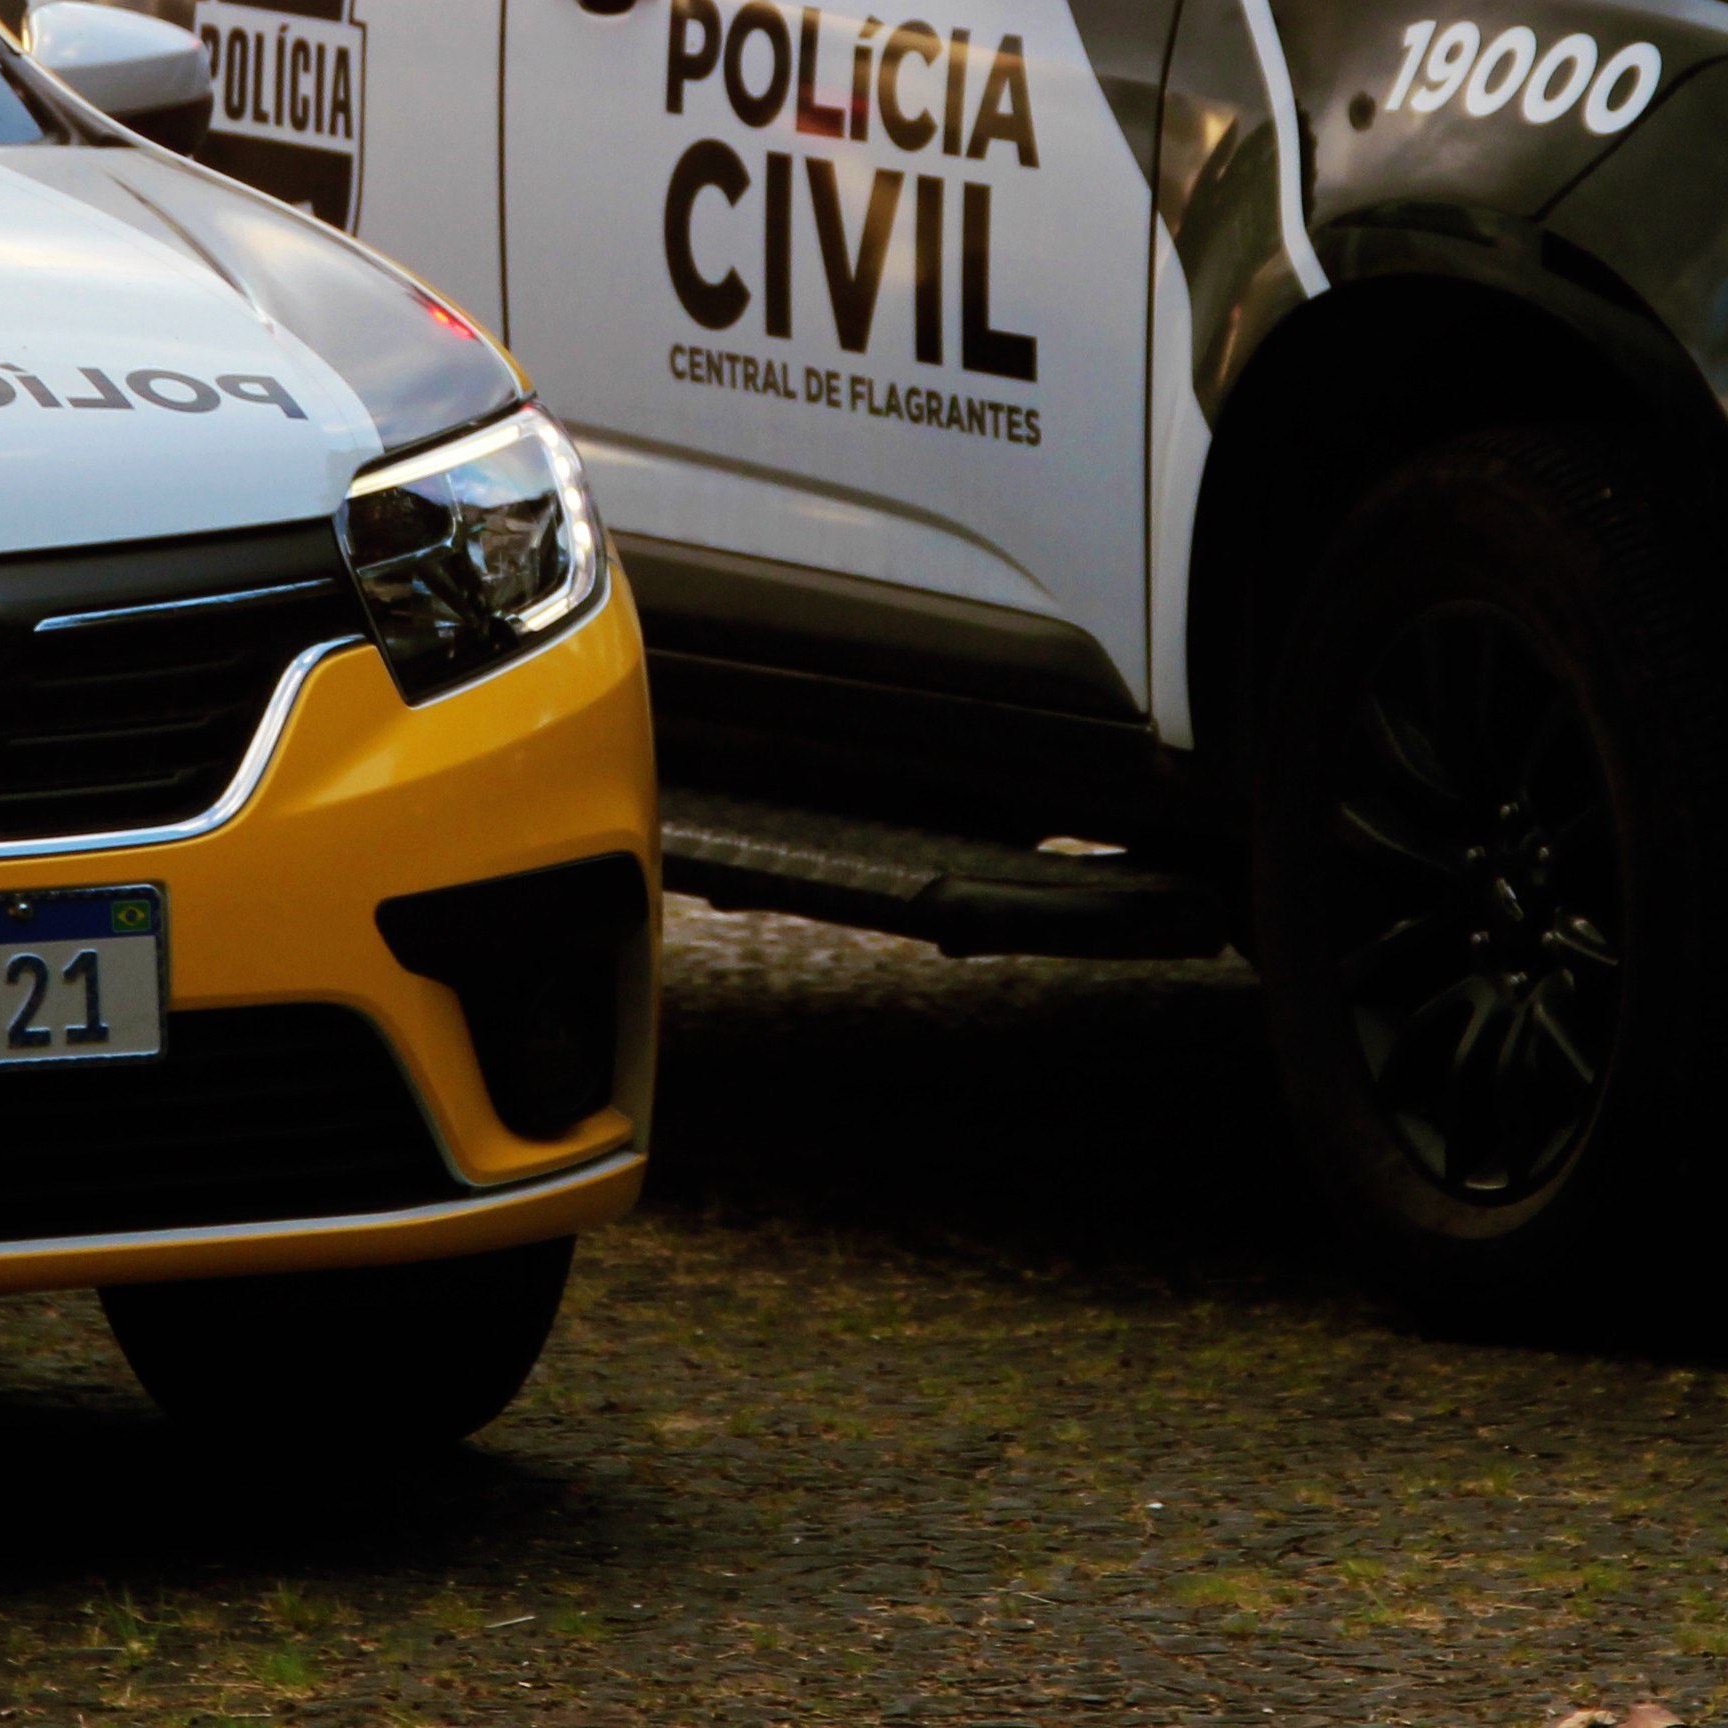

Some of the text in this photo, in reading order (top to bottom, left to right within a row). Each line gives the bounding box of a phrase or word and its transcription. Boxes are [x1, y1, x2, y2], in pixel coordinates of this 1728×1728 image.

[200, 22, 354, 140] POLÍCIA
[1385, 19, 1663, 135] 19000
[664, 138, 1038, 383] CIVIL
[669, 343, 1042, 448] CENTRAL DE FLAGRANTES
